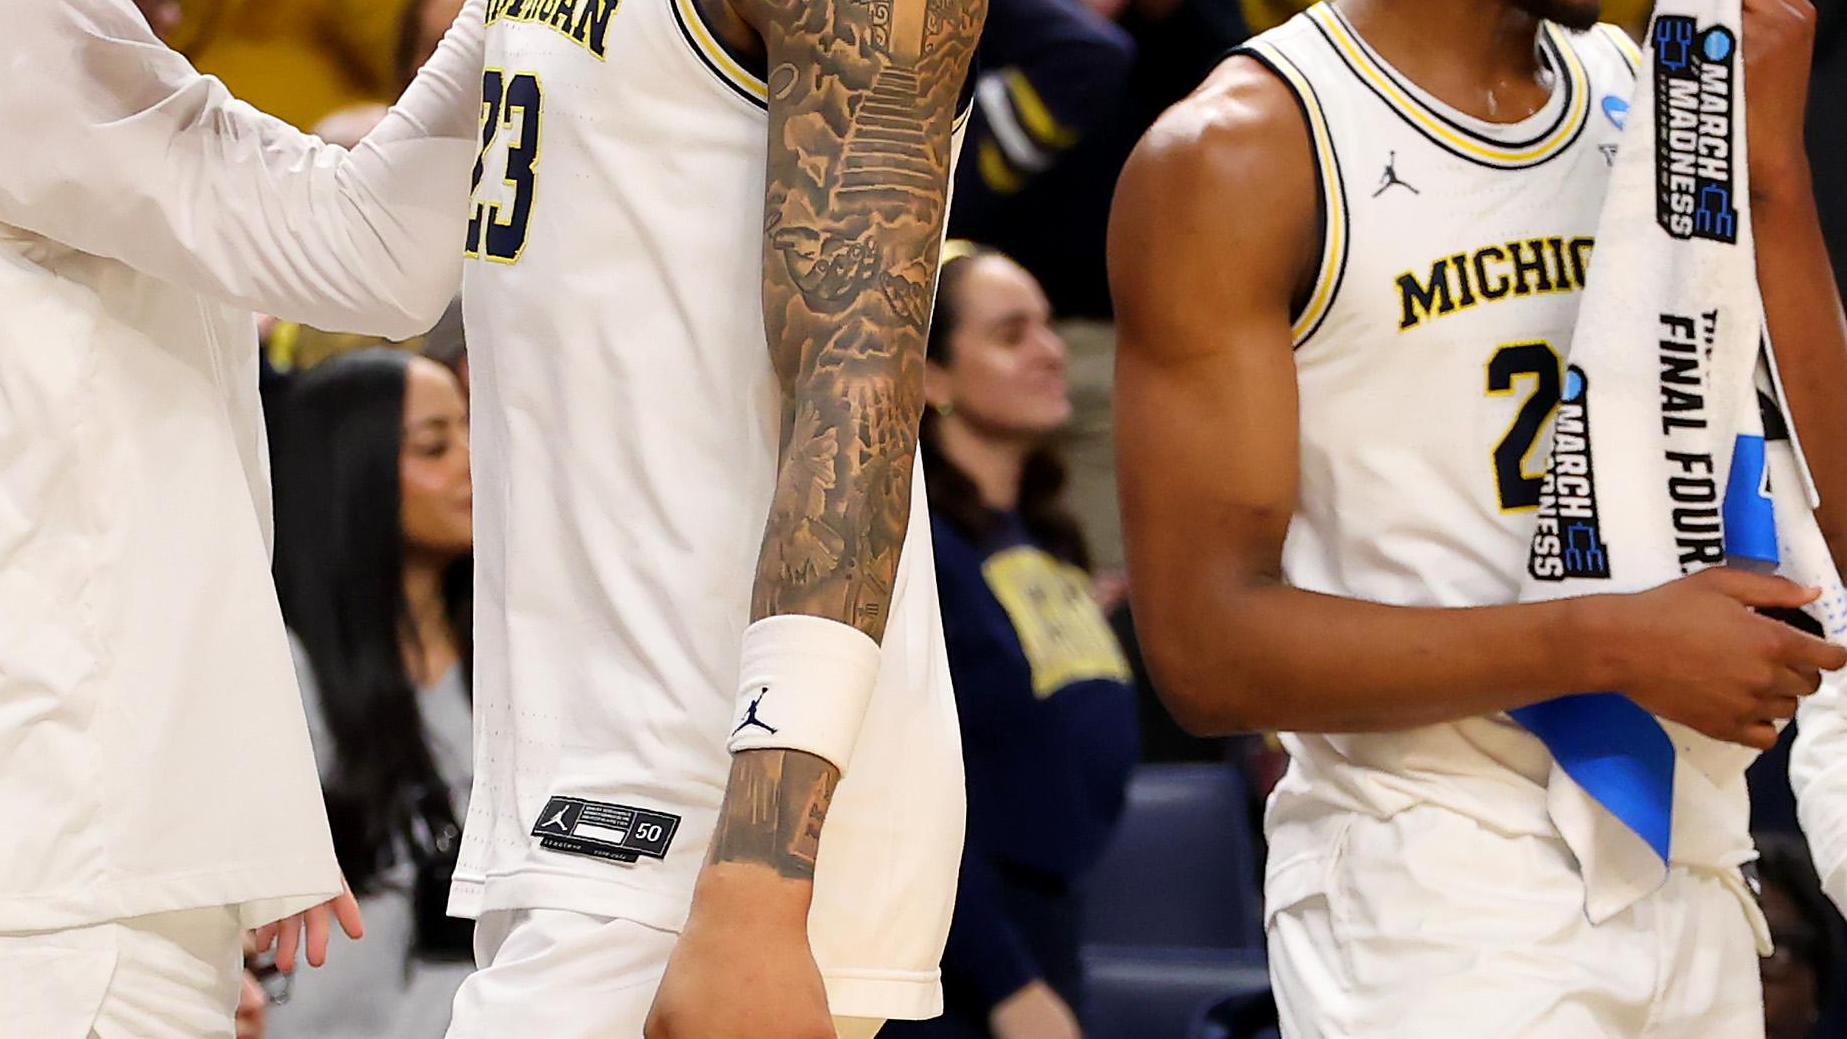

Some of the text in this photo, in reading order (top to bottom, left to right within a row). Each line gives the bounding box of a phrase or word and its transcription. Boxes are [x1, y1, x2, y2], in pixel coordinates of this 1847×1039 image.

[463, 66, 544, 266] 23
[1667, 77, 1700, 237] MADNESS
[1697, 62, 1730, 182] MARCH
[1484, 338, 1563, 514] 2
[1658, 312, 1709, 437] FINAL
[1554, 403, 1594, 519] MARCH
[635, 822, 662, 842] 50
